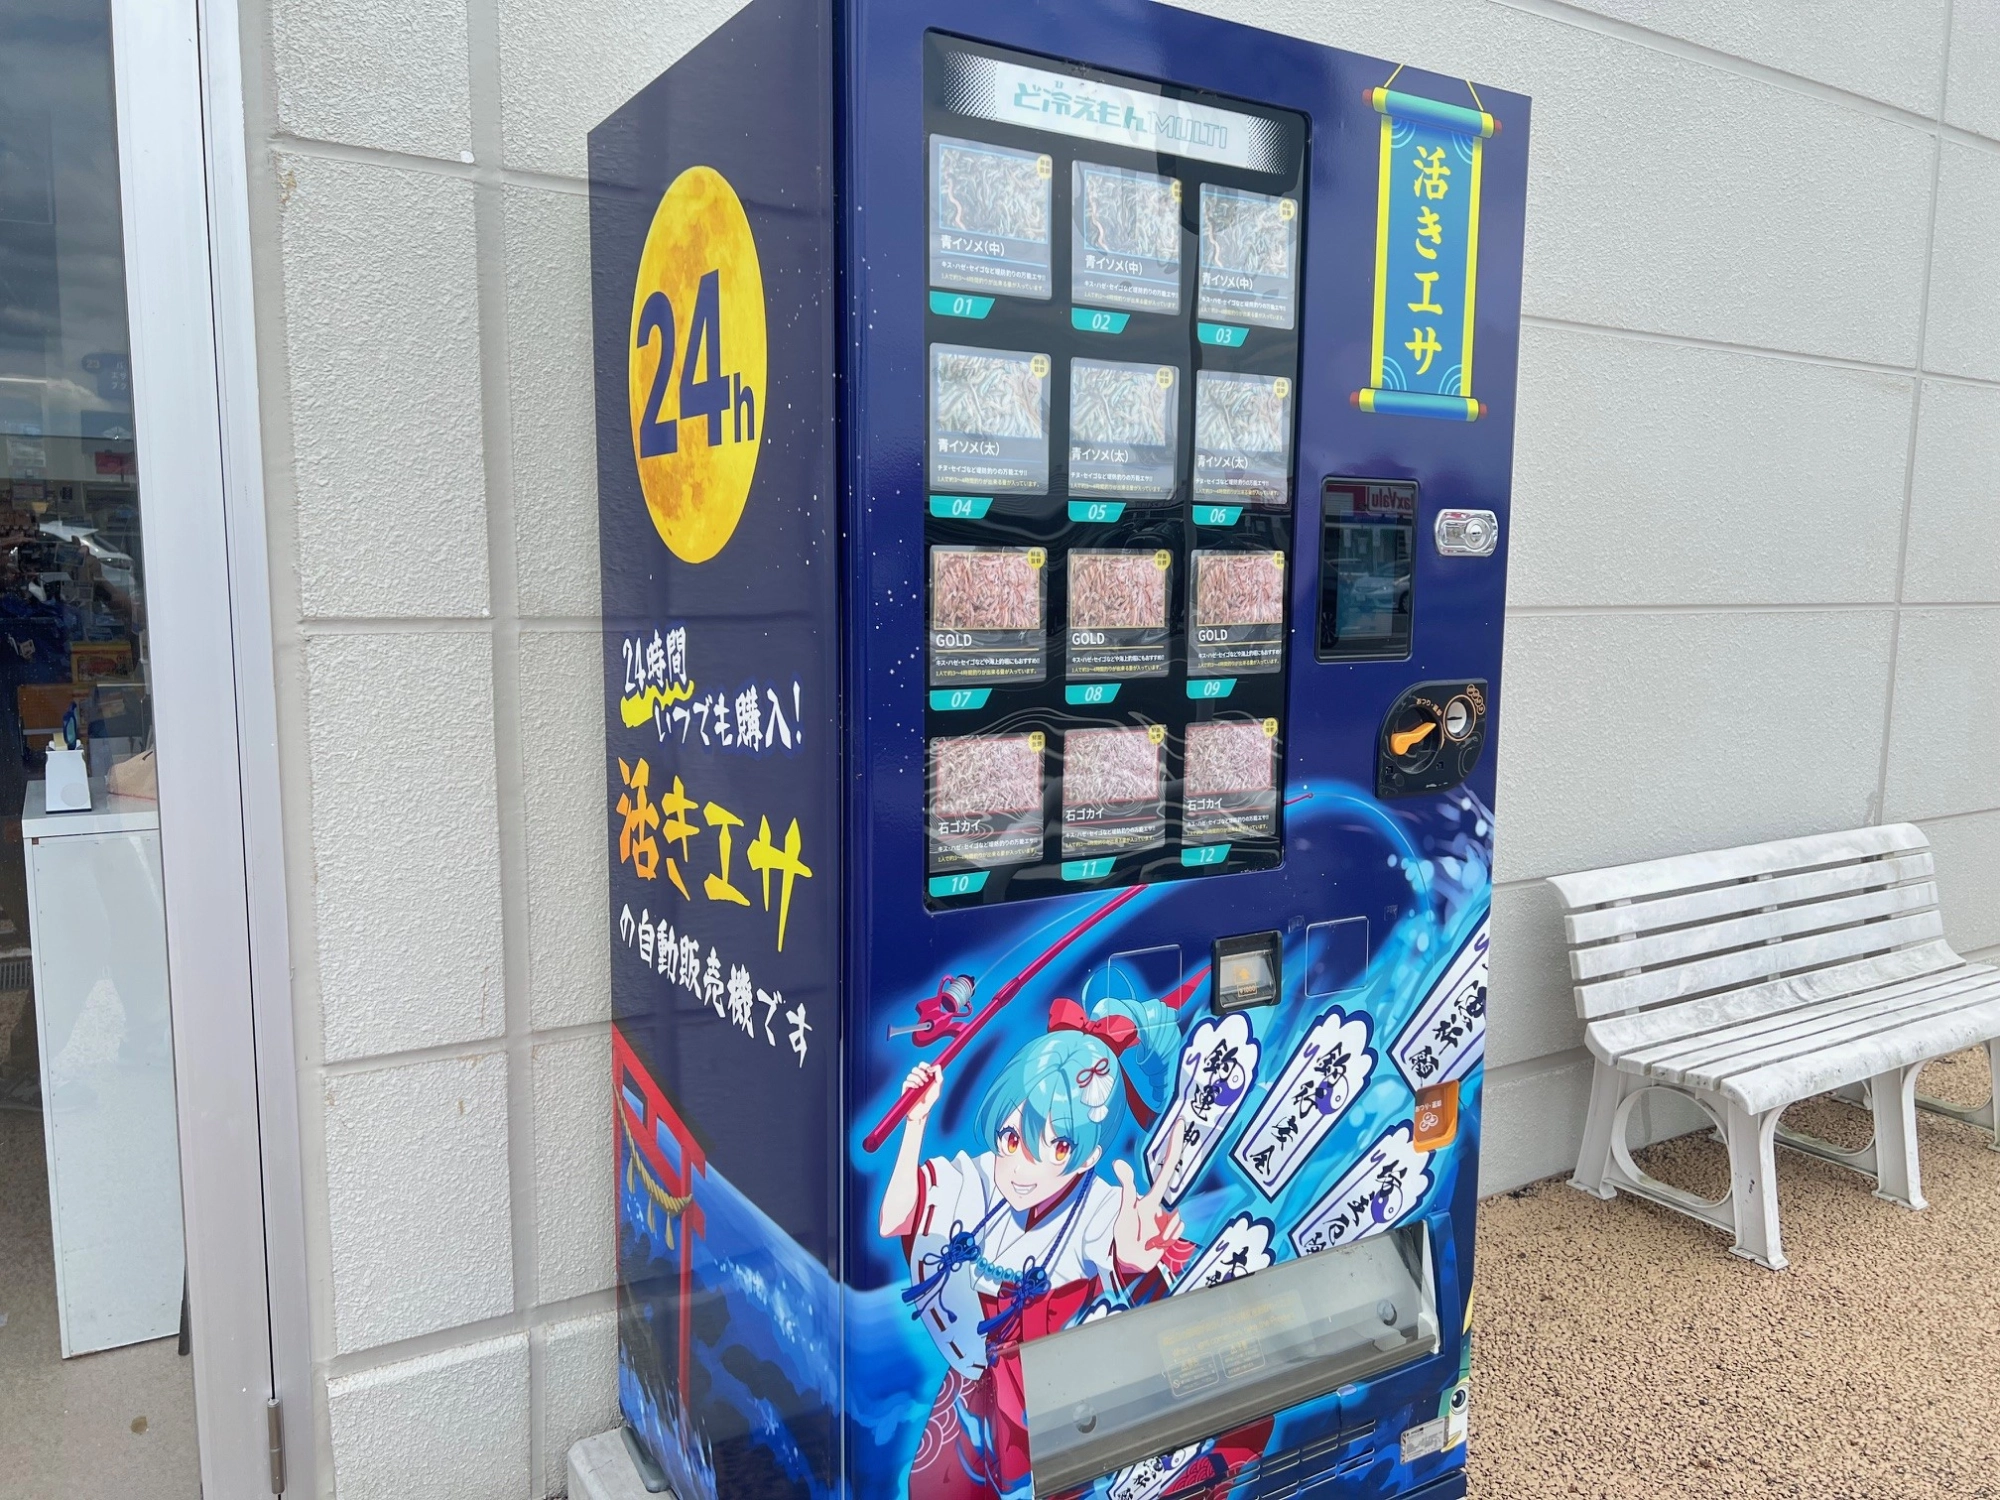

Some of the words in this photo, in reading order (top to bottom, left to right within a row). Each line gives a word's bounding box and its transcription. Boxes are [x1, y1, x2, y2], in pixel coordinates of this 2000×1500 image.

[1013, 83, 1147, 132] ど冷えもん
[1148, 111, 1227, 149] MULTI
[940, 234, 1005, 257] 青イソメ(中)
[1085, 255, 1143, 275] 青イソメ(中)
[1404, 146, 1451, 375] 活きエサ
[1202, 272, 1253, 290] 青イソメ(中)
[953, 298, 972, 316] 01
[1092, 313, 1109, 330] 02
[1215, 328, 1232, 344] 03
[636, 268, 756, 459] 24h
[938, 438, 1000, 456] 青イソメ(太)
[1071, 447, 1128, 463] 青イソメ(太)
[1197, 454, 1248, 469] 青イソメ(太)
[952, 499, 972, 516] 04
[1087, 503, 1106, 519] 05
[1209, 508, 1226, 523] 06
[935, 633, 972, 647] GOLD
[1072, 632, 1105, 645] GOLD
[1198, 629, 1228, 642] GOLD
[622, 626, 687, 694] 24時間
[1085, 686, 1102, 702] 08
[1203, 681, 1220, 696] 09
[951, 691, 971, 707] 07
[653, 681, 803, 752] いつでも購入!
[1187, 798, 1223, 811] 石ゴカイ
[1065, 807, 1104, 822] 石ゴカイ
[938, 819, 981, 835] 石ゴカイ
[616, 757, 813, 952] 活きエサ
[1199, 848, 1215, 863] 12
[1081, 861, 1097, 876] 11
[951, 876, 969, 892] 10
[620, 903, 813, 1068] の自動販売機です
[1408, 963, 1488, 1087] 漁祈願
[1249, 1041, 1352, 1176] 釣行安全
